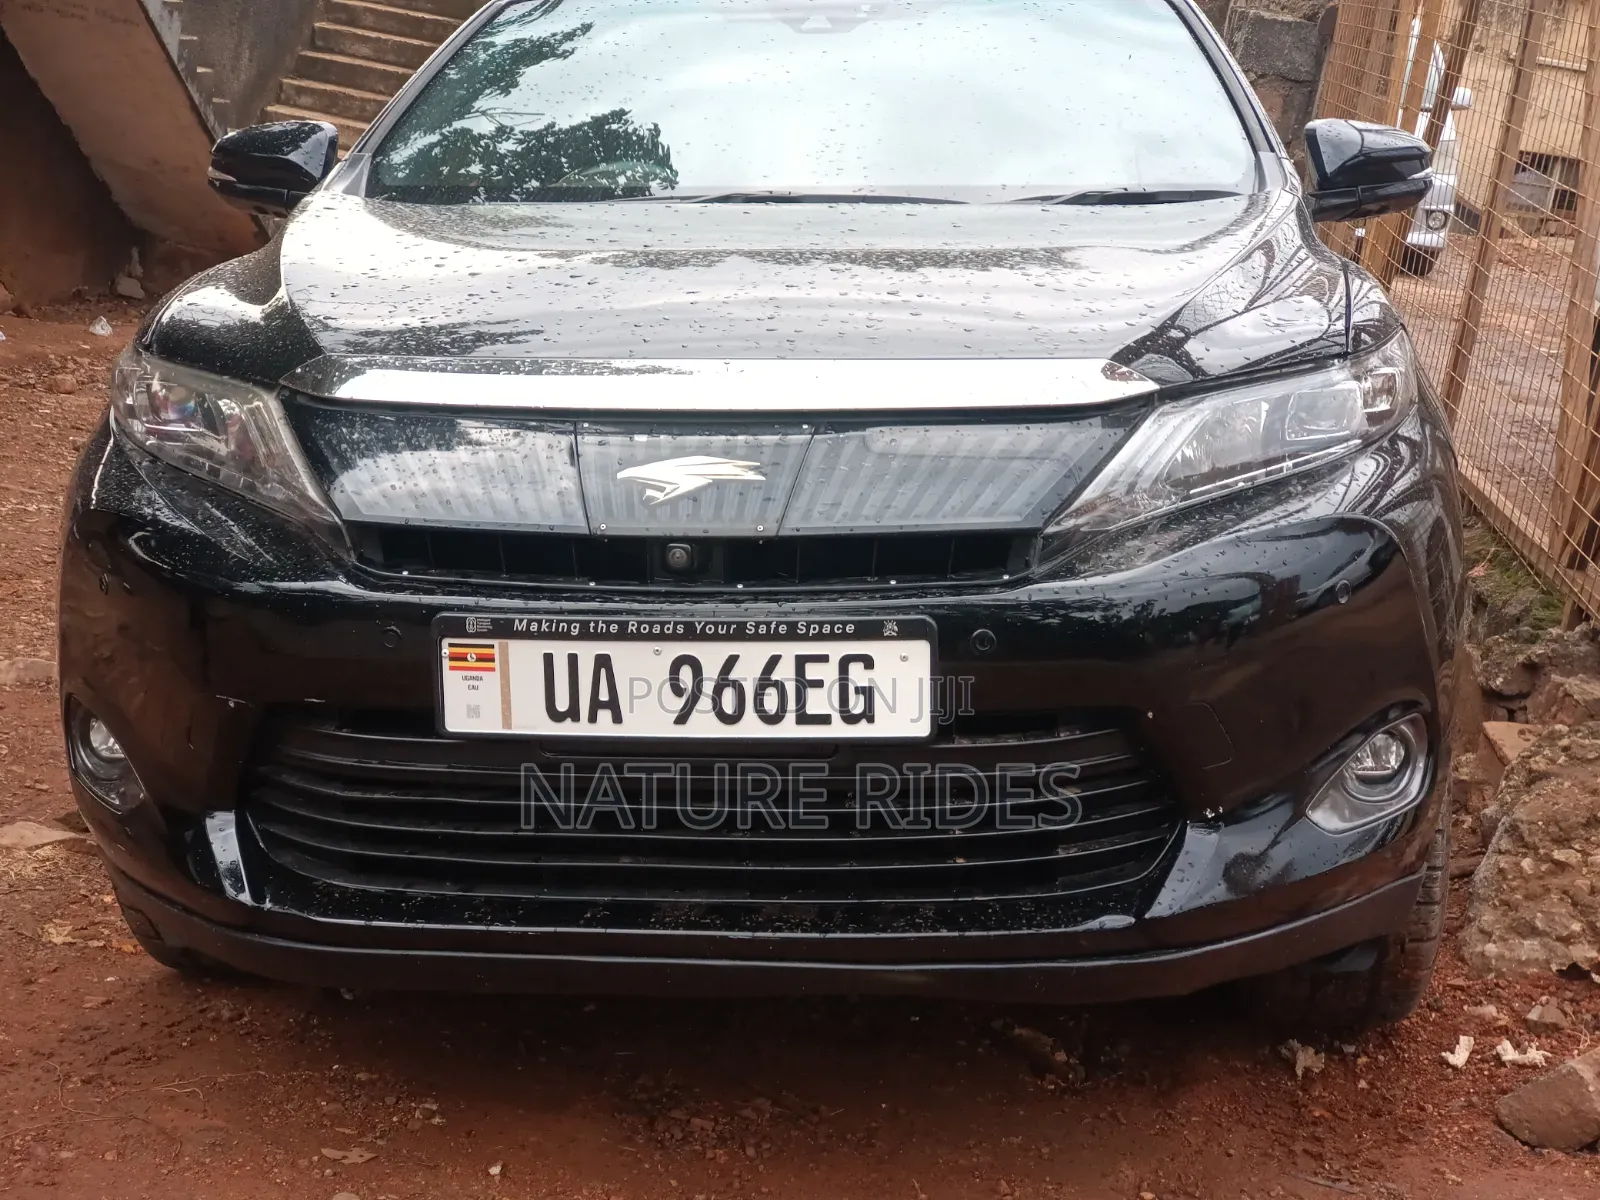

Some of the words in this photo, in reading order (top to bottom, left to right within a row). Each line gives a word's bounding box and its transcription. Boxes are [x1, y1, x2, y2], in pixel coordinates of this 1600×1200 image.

[513, 618, 580, 635] Making
[589, 620, 618, 633] the
[628, 621, 685, 634] Roads
[694, 621, 737, 634] Your
[745, 621, 788, 634] Safe
[797, 621, 855, 636] Space
[543, 652, 623, 724] UA
[668, 653, 875, 725] 966EG
